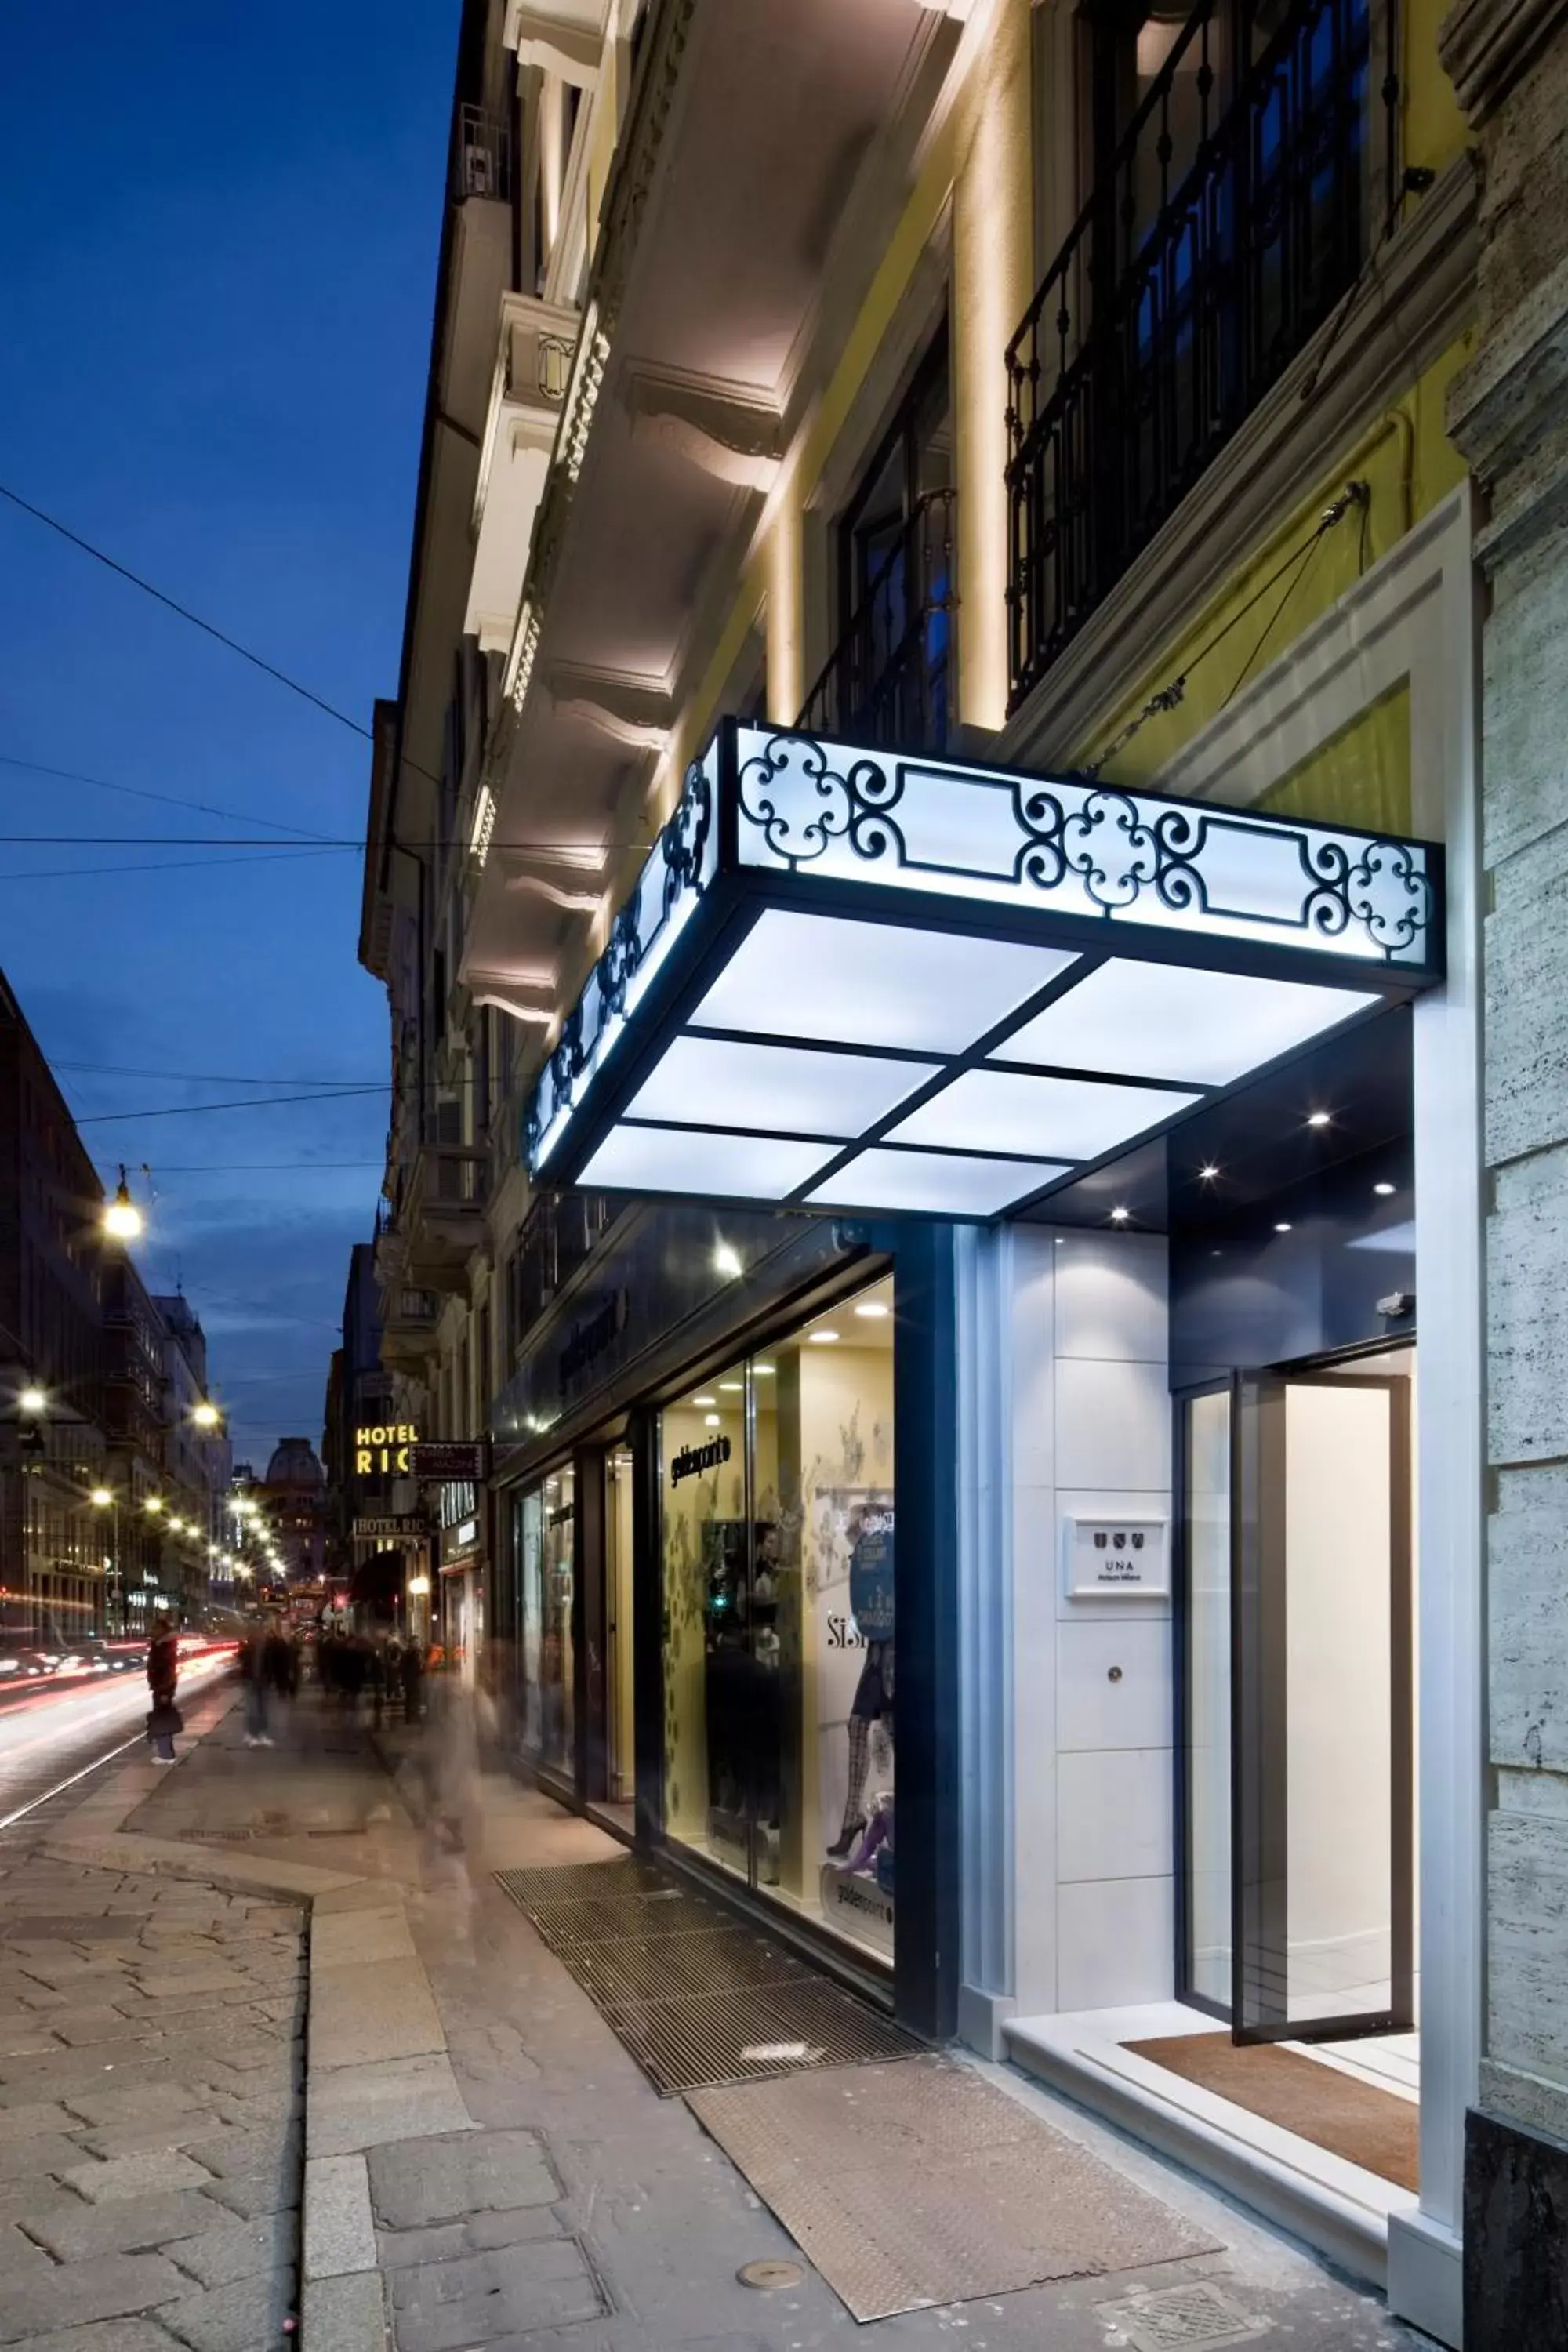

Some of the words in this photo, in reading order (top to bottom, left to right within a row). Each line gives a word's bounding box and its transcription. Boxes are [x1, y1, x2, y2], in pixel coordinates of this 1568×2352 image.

[357, 1425, 419, 1446] HOTEL
[358, 1518, 400, 1534] HOTEL
[1105, 1560, 1134, 1571] UNA
